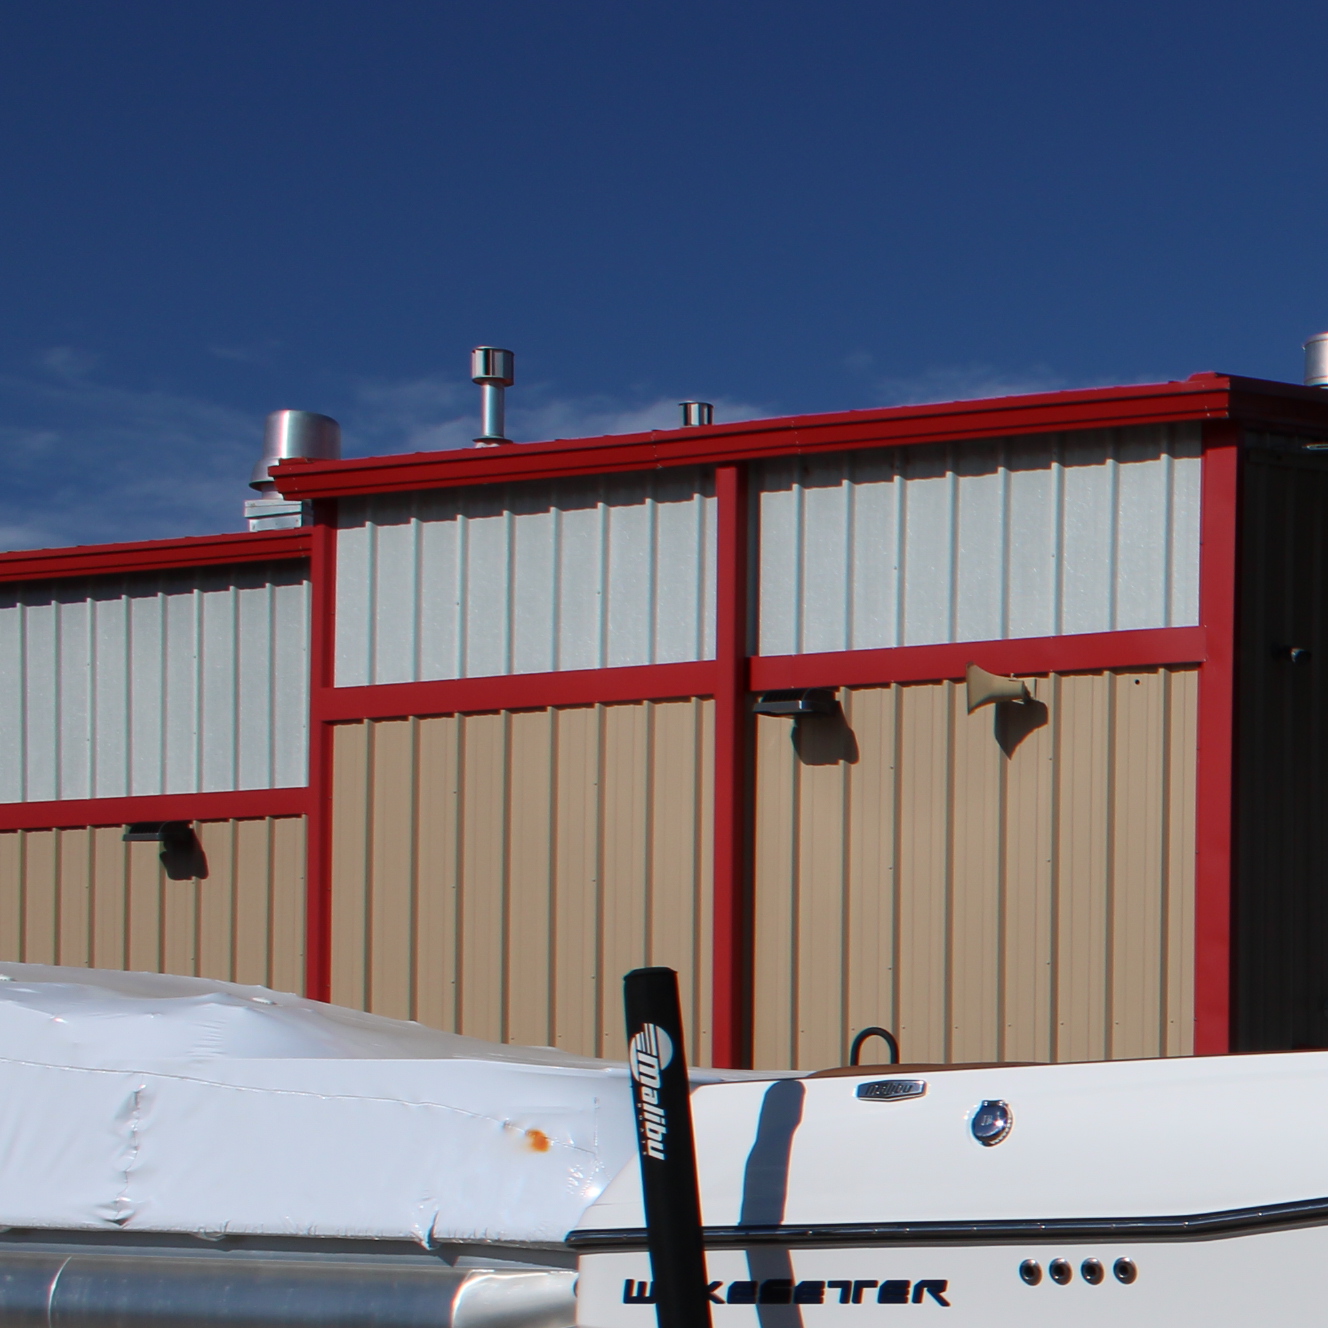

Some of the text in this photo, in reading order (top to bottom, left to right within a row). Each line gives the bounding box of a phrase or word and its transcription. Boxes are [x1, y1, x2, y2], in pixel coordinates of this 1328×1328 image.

[865, 1081, 914, 1096] Malibu
[636, 1049, 667, 1161] Malibu
[622, 1278, 951, 1307] WKESETTER
